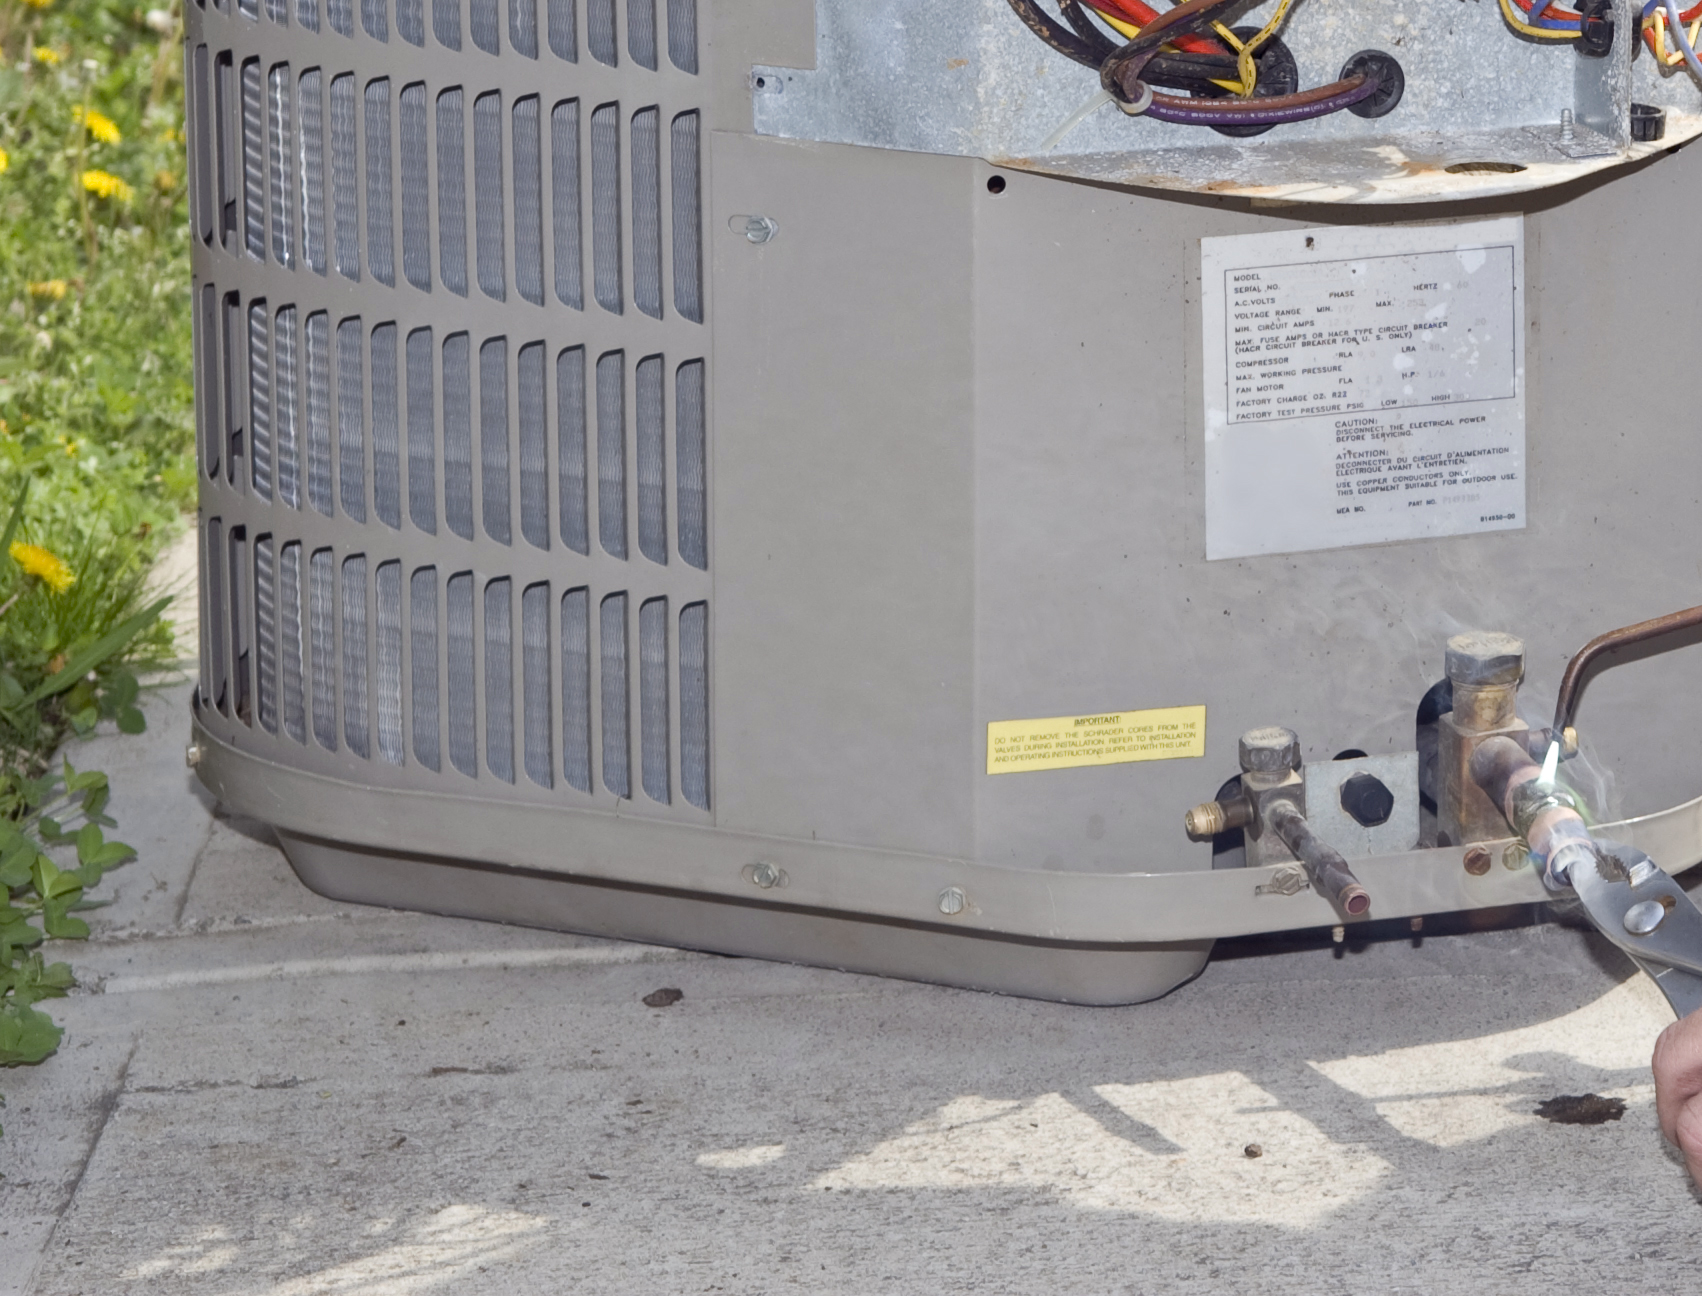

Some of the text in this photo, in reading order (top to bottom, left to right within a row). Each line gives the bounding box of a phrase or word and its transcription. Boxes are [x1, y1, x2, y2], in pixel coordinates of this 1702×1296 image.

[1234, 273, 1261, 282] MODEL
[1234, 285, 1262, 294] SERIAL
[1413, 283, 1438, 291] HERTZ
[1329, 290, 1355, 298] PHASE
[1234, 311, 1269, 320] VOLTAGE
[1275, 308, 1301, 318] RANGE
[1257, 322, 1288, 331] CIRCUIT
[1293, 320, 1315, 328] AMPS
[1260, 336, 1279, 344] FUSE
[1285, 333, 1307, 342] AMPS
[1354, 328, 1373, 336] TYPE
[1378, 324, 1408, 333] CIRCUIT
[1413, 321, 1448, 331] BREAKER
[1235, 345, 1261, 354] (HACR
[1266, 342, 1296, 351] CIRCUIT
[1301, 338, 1337, 348] BREAKER
[1235, 357, 1289, 368] COMPRESSOR
[1260, 370, 1296, 379] WORKING
[1302, 365, 1342, 375] PRESSURE
[1257, 384, 1284, 392] MOTOR
[1236, 398, 1271, 407] FACTORY
[1277, 395, 1307, 404] CHARGE
[1236, 411, 1272, 420] FACTORY
[1300, 404, 1341, 414] PRESSURE
[1381, 399, 1398, 407] LOW
[1336, 426, 1384, 436] DISCONNECT
[1409, 420, 1454, 429] ELECTRICAL
[1459, 416, 1486, 424] POWER
[1336, 434, 1365, 443] BEFORE
[1412, 453, 1442, 462] CIRCUIT
[1356, 477, 1387, 487] COPPER
[1392, 472, 1444, 483] CONDUCTORS
[1358, 484, 1399, 495] EQUIPMENT
[1405, 480, 1437, 490] SUITABLE
[1442, 478, 1457, 486] FOR
[1461, 475, 1496, 484] OUTDOOR
